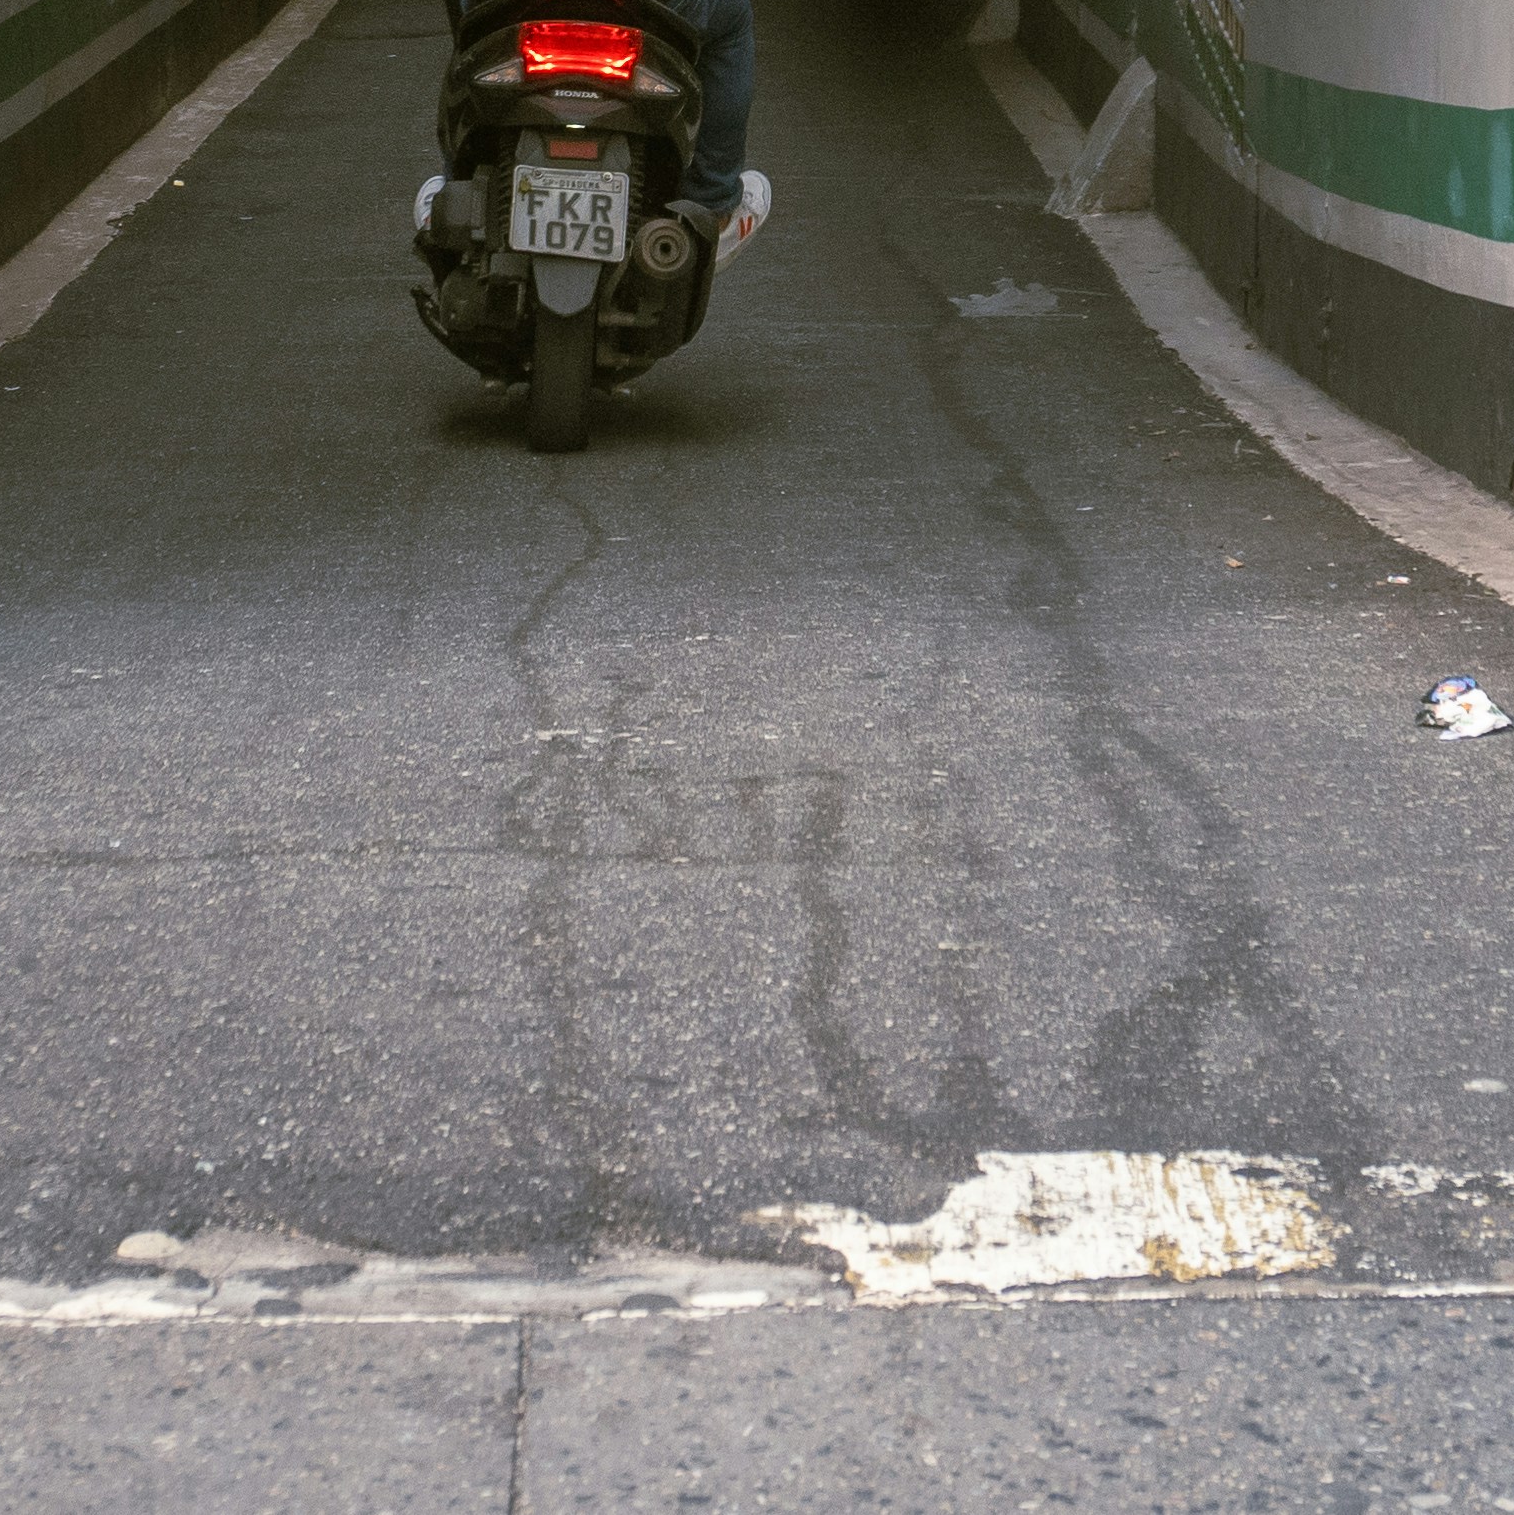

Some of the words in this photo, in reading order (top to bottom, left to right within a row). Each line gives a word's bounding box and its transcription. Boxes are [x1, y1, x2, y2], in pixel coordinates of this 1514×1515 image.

[554, 89, 599, 99] HONDA
[527, 189, 613, 224] FKR
[528, 219, 614, 255] 1079
